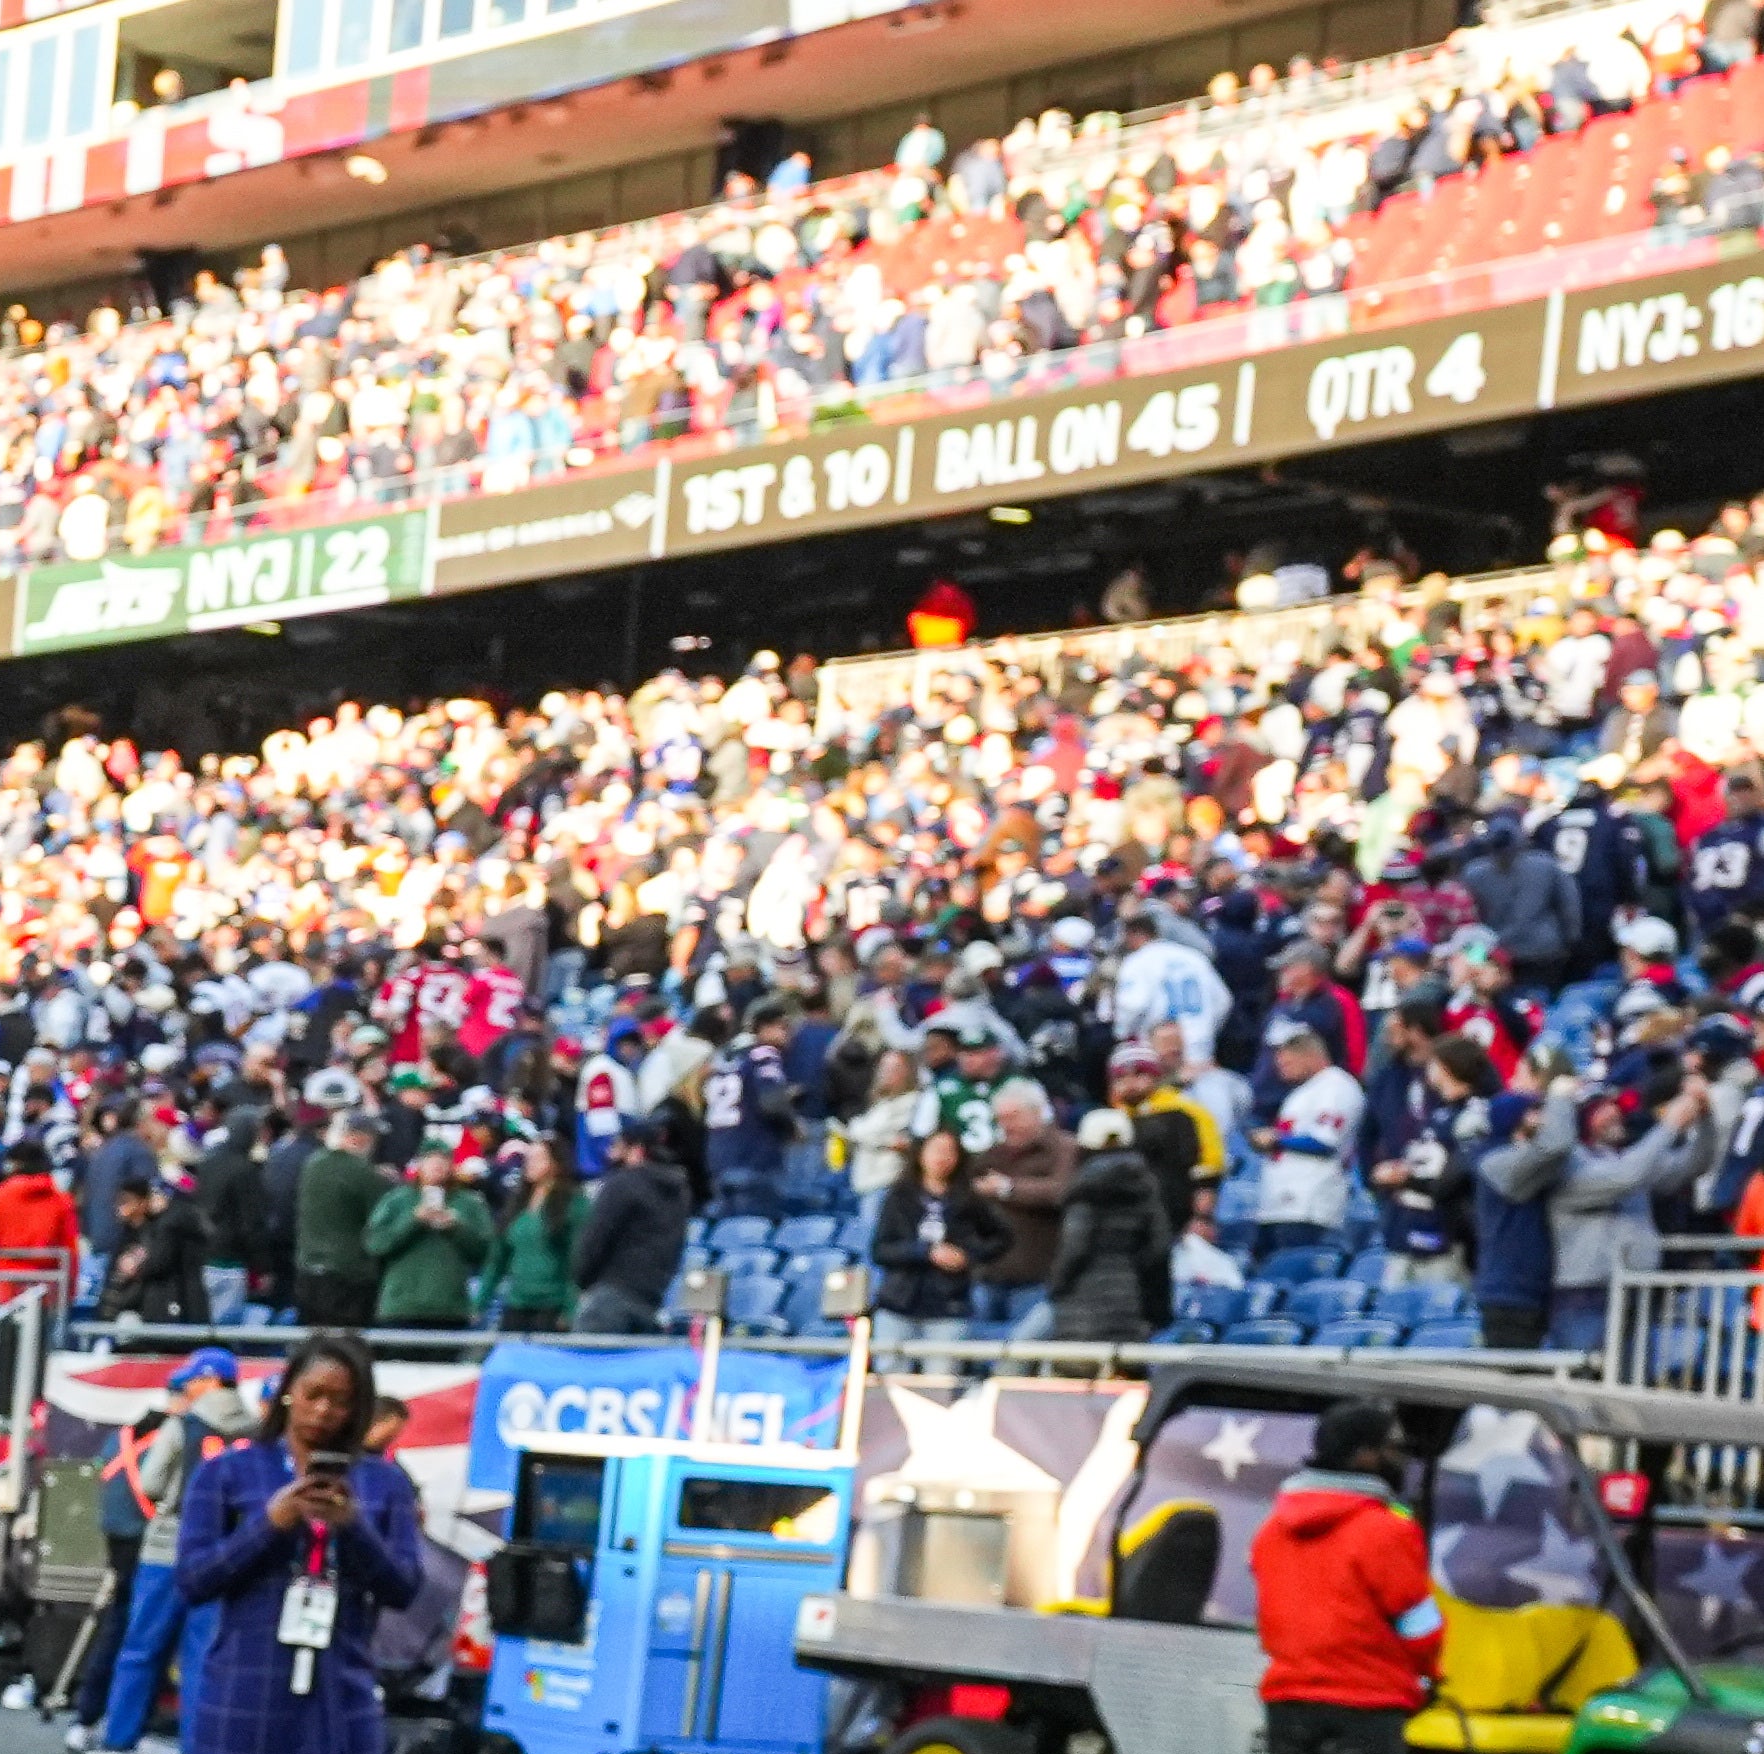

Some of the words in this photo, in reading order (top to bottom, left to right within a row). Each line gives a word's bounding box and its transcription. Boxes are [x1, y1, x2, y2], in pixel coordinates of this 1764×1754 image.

[1576, 290, 1704, 376] NYJ:
[1306, 345, 1416, 442] QTR
[1425, 331, 1487, 404] 4
[934, 417, 1040, 494] BALL
[1048, 399, 1122, 477] ON
[1126, 381, 1222, 459] 45
[683, 460, 776, 535] 1ST
[778, 454, 816, 519] &
[822, 442, 892, 510] 10
[185, 538, 293, 613] NYJ
[321, 524, 390, 595] 22
[546, 1384, 662, 1438] CBS
